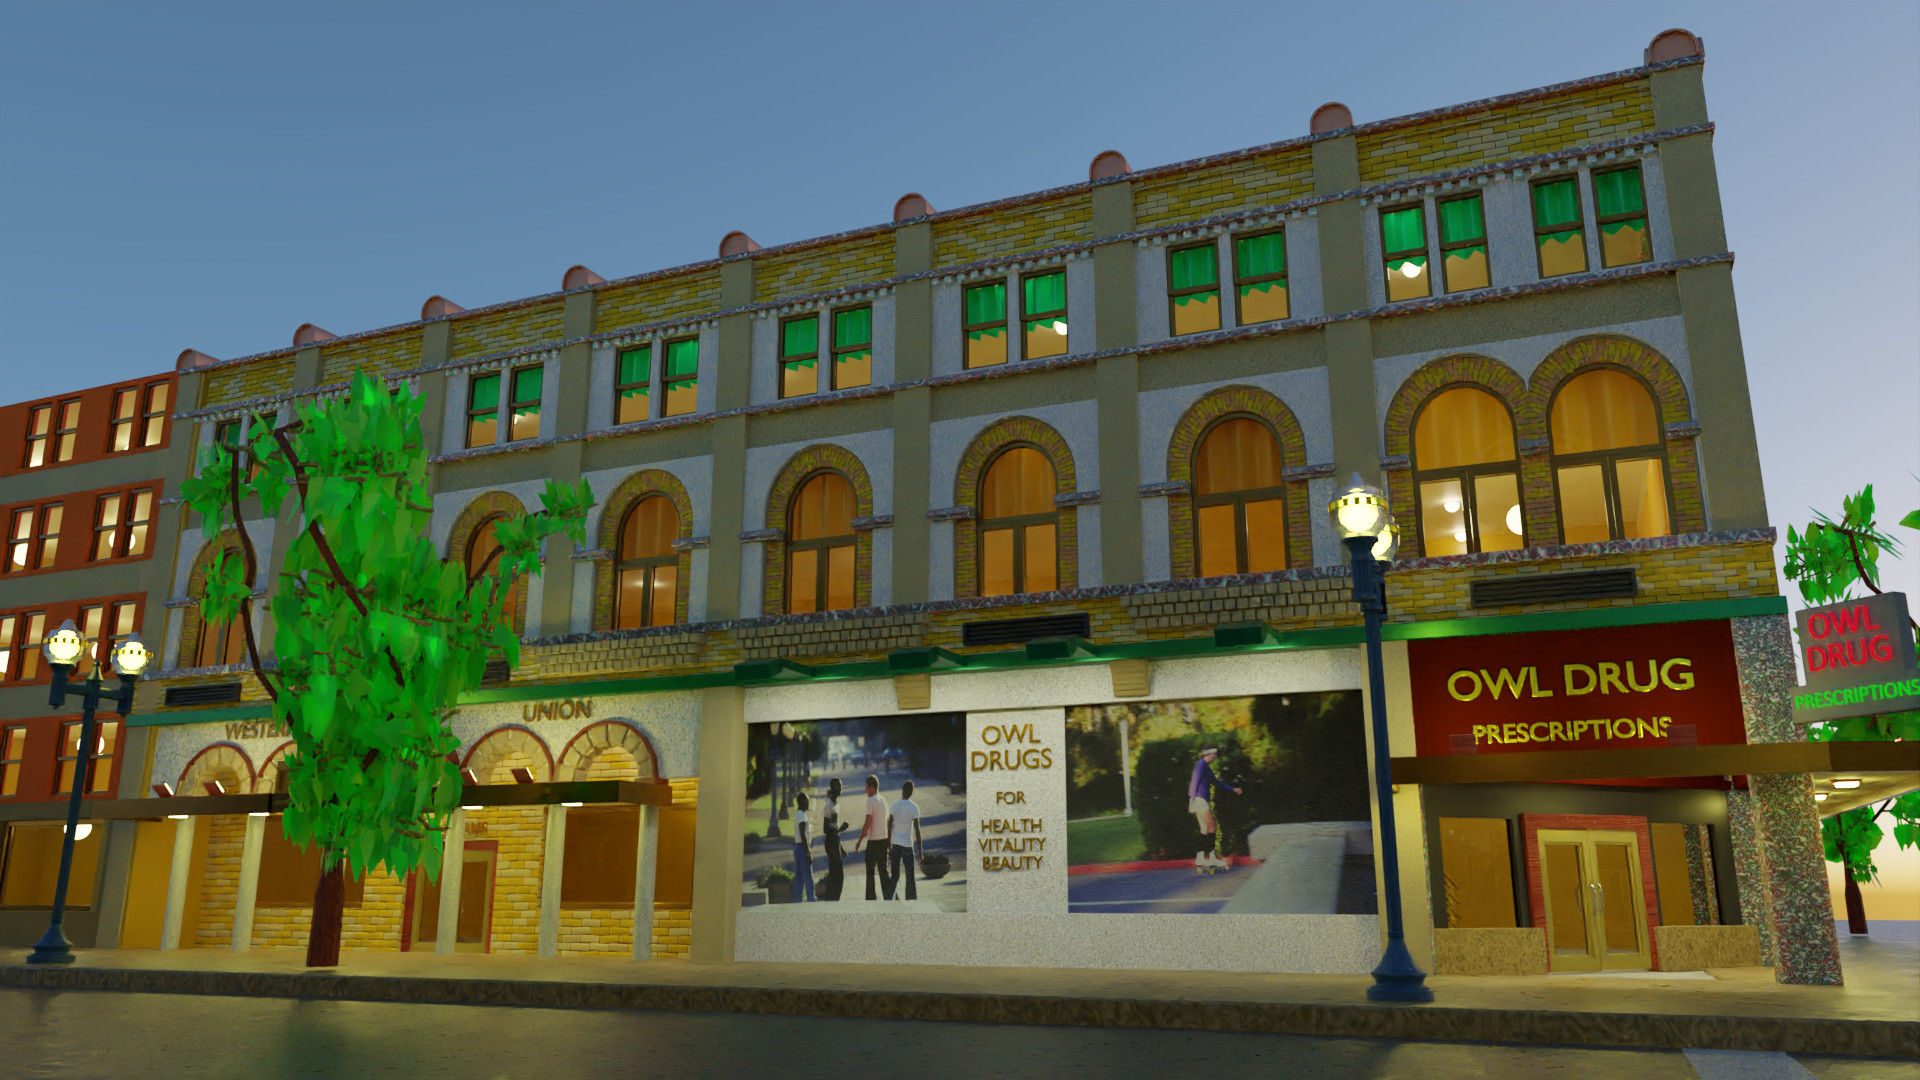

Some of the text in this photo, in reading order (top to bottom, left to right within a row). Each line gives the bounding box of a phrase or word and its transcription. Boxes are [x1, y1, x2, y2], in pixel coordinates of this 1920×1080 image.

[1807, 604, 1881, 640] OWL
[1806, 634, 1893, 673] DRUG
[1447, 657, 1696, 702] OWL DRUG
[1794, 678, 1920, 711] PRESCRIPTIONS
[522, 700, 592, 723] UNION
[981, 723, 1041, 746] OWL
[1472, 716, 1673, 746] PRESCRIPTIONS
[970, 748, 1053, 772] DRUGS
[996, 791, 1026, 805] FOR
[981, 818, 1042, 834] HEALTH
[978, 837, 1047, 852] VITALITY
[982, 855, 1044, 871] BEAUTY
